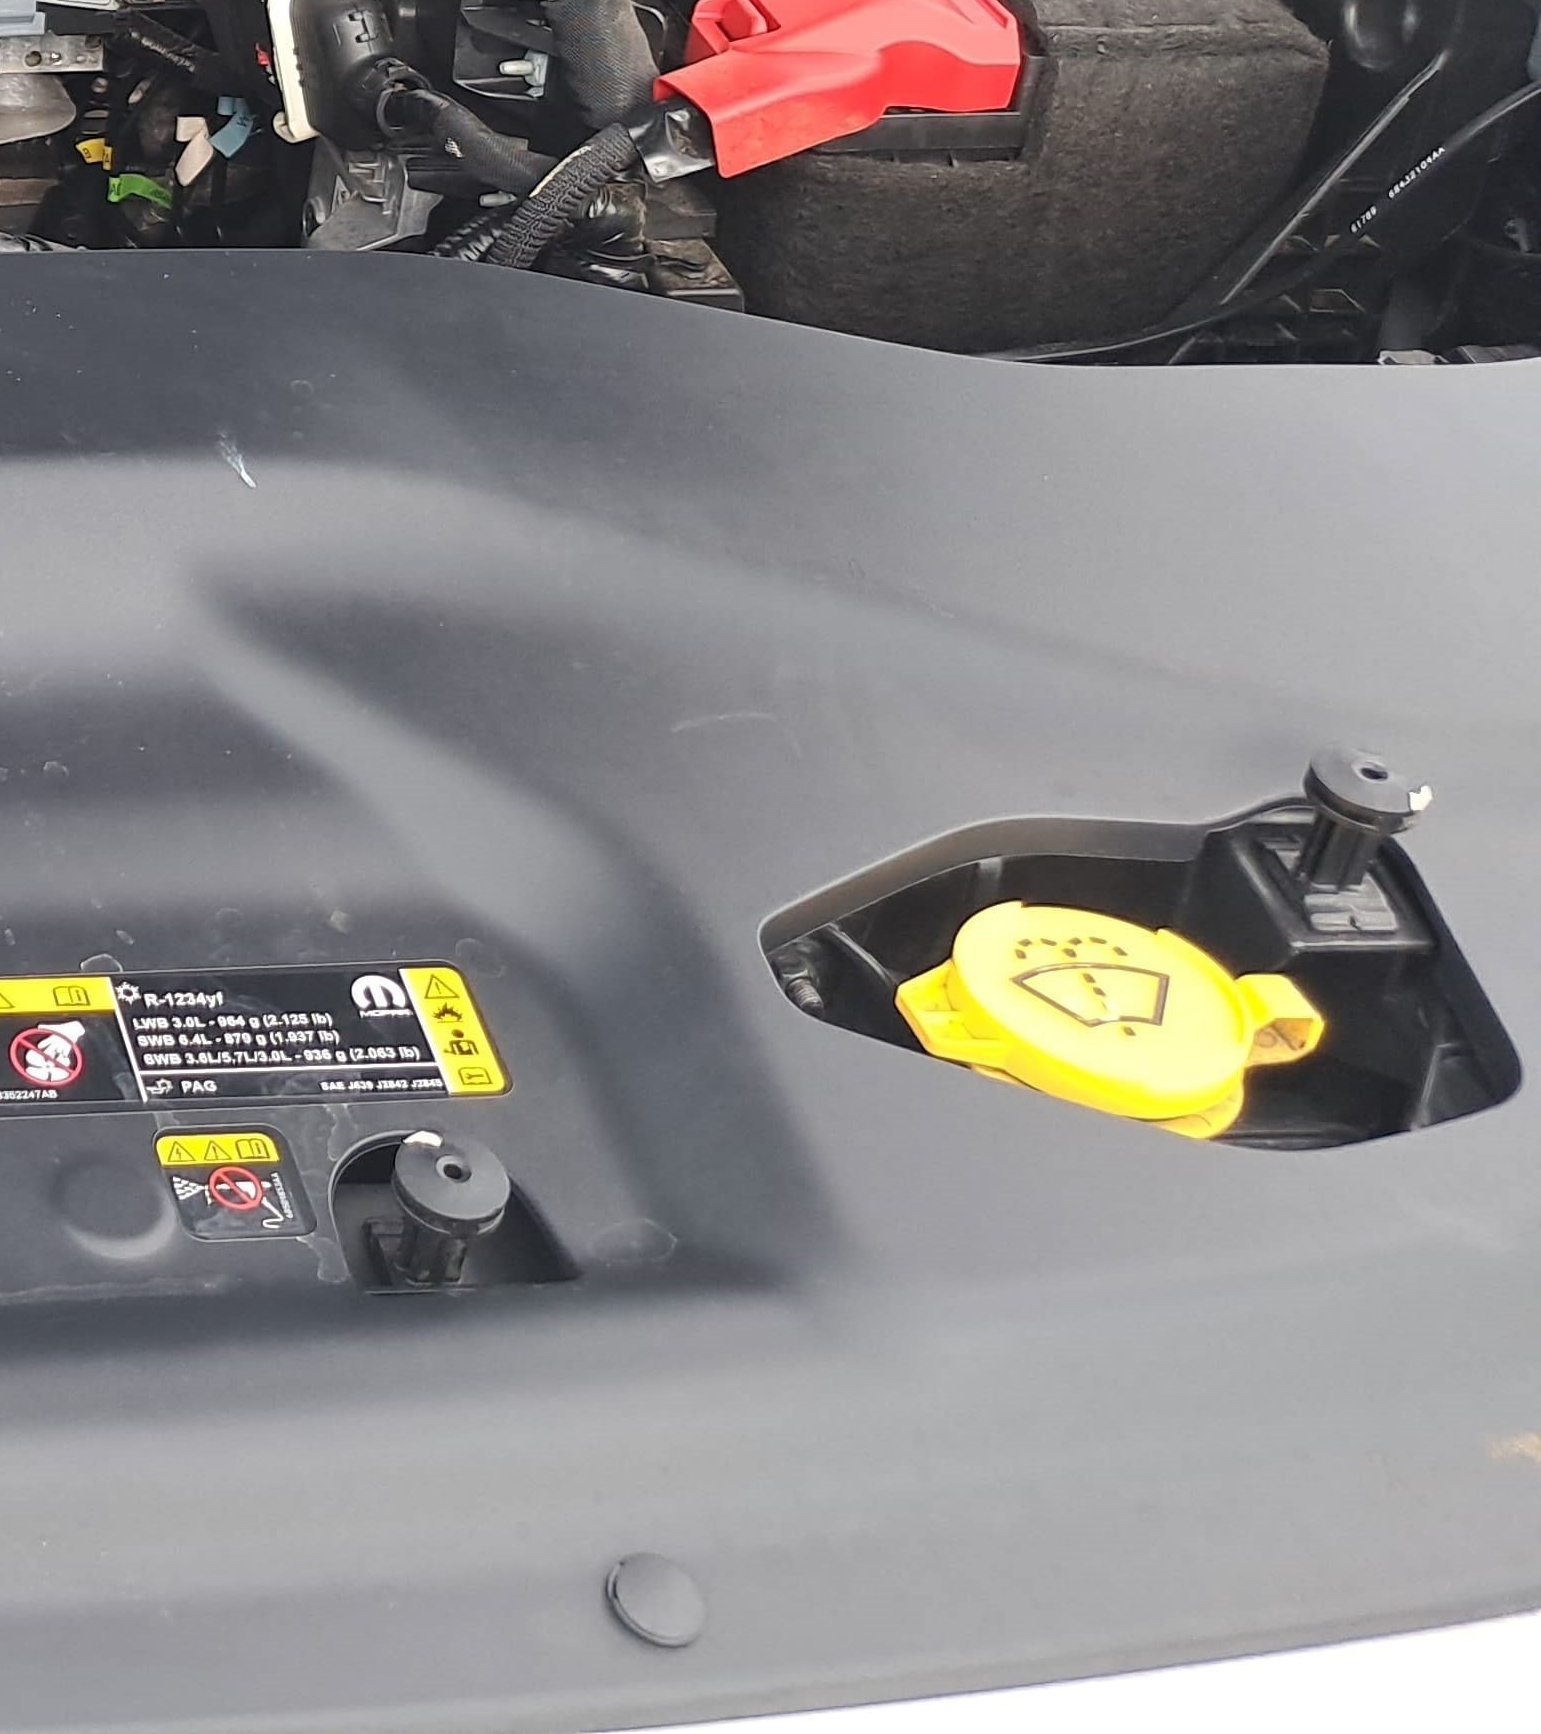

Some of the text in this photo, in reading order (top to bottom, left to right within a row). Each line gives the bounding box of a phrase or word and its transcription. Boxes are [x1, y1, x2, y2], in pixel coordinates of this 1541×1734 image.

[143, 991, 224, 1008] R-1234yf
[133, 1017, 169, 1030] LWB
[172, 1016, 207, 1028] 3.0L
[217, 1015, 246, 1027] 964
[249, 1016, 260, 1029] g
[262, 1013, 309, 1027] (2.125
[311, 1012, 333, 1028] lb)
[137, 1034, 176, 1046] SWB
[178, 1033, 213, 1045] 6.4L
[224, 1032, 252, 1044] 879
[255, 1034, 267, 1046] g
[269, 1030, 315, 1045] (1.937
[317, 1029, 340, 1044] lb)
[143, 1052, 182, 1065] SWB
[303, 1049, 332, 1061] 936
[335, 1050, 347, 1063] g
[349, 1047, 396, 1062] (2.063
[398, 1046, 421, 1061] lb)
[181, 1079, 217, 1092] PAG
